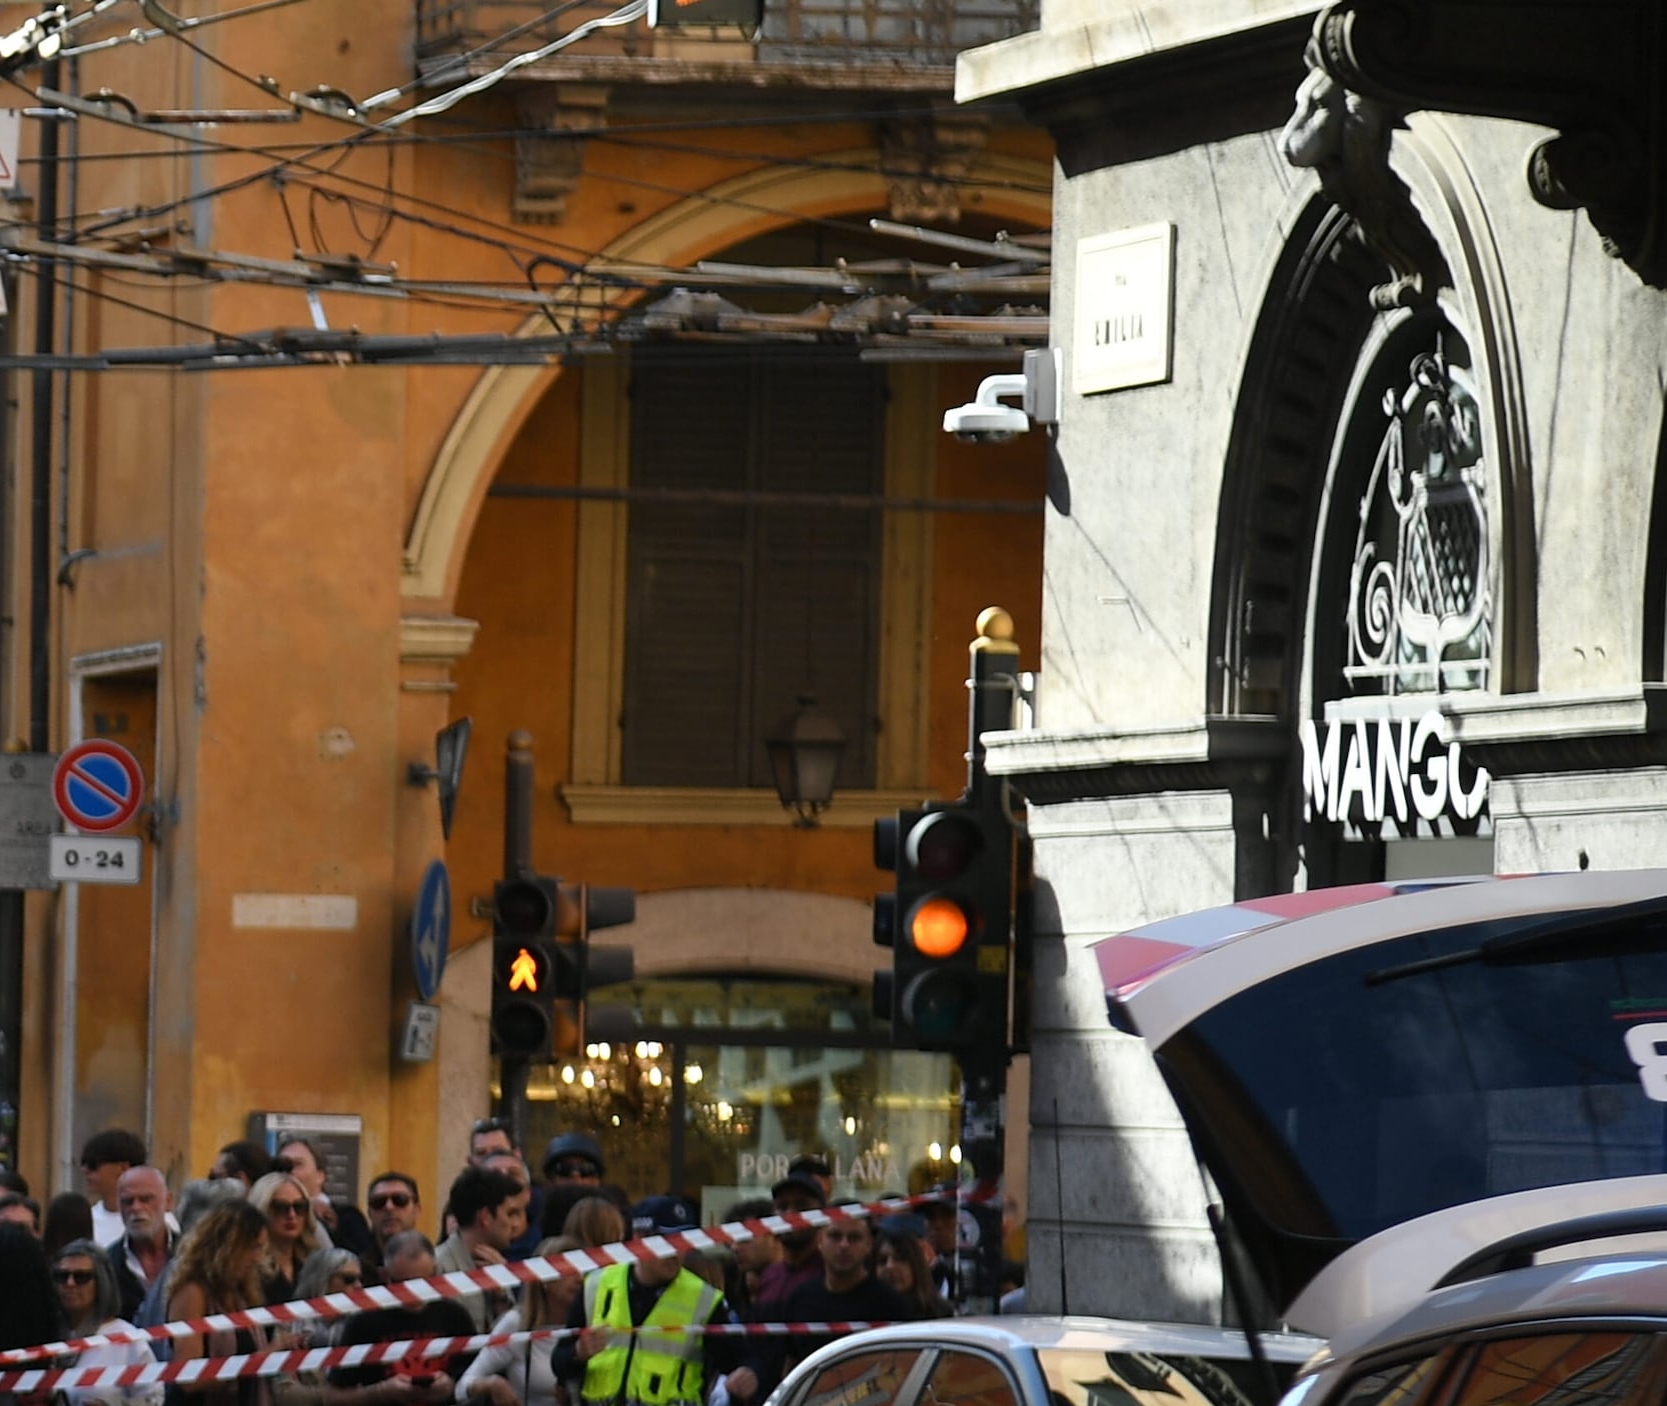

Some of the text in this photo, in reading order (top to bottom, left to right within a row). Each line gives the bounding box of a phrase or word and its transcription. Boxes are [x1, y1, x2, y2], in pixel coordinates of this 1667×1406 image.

[64, 849, 79, 866] 0
[95, 850, 124, 868] 24
[740, 1152, 901, 1182] PORLANA
